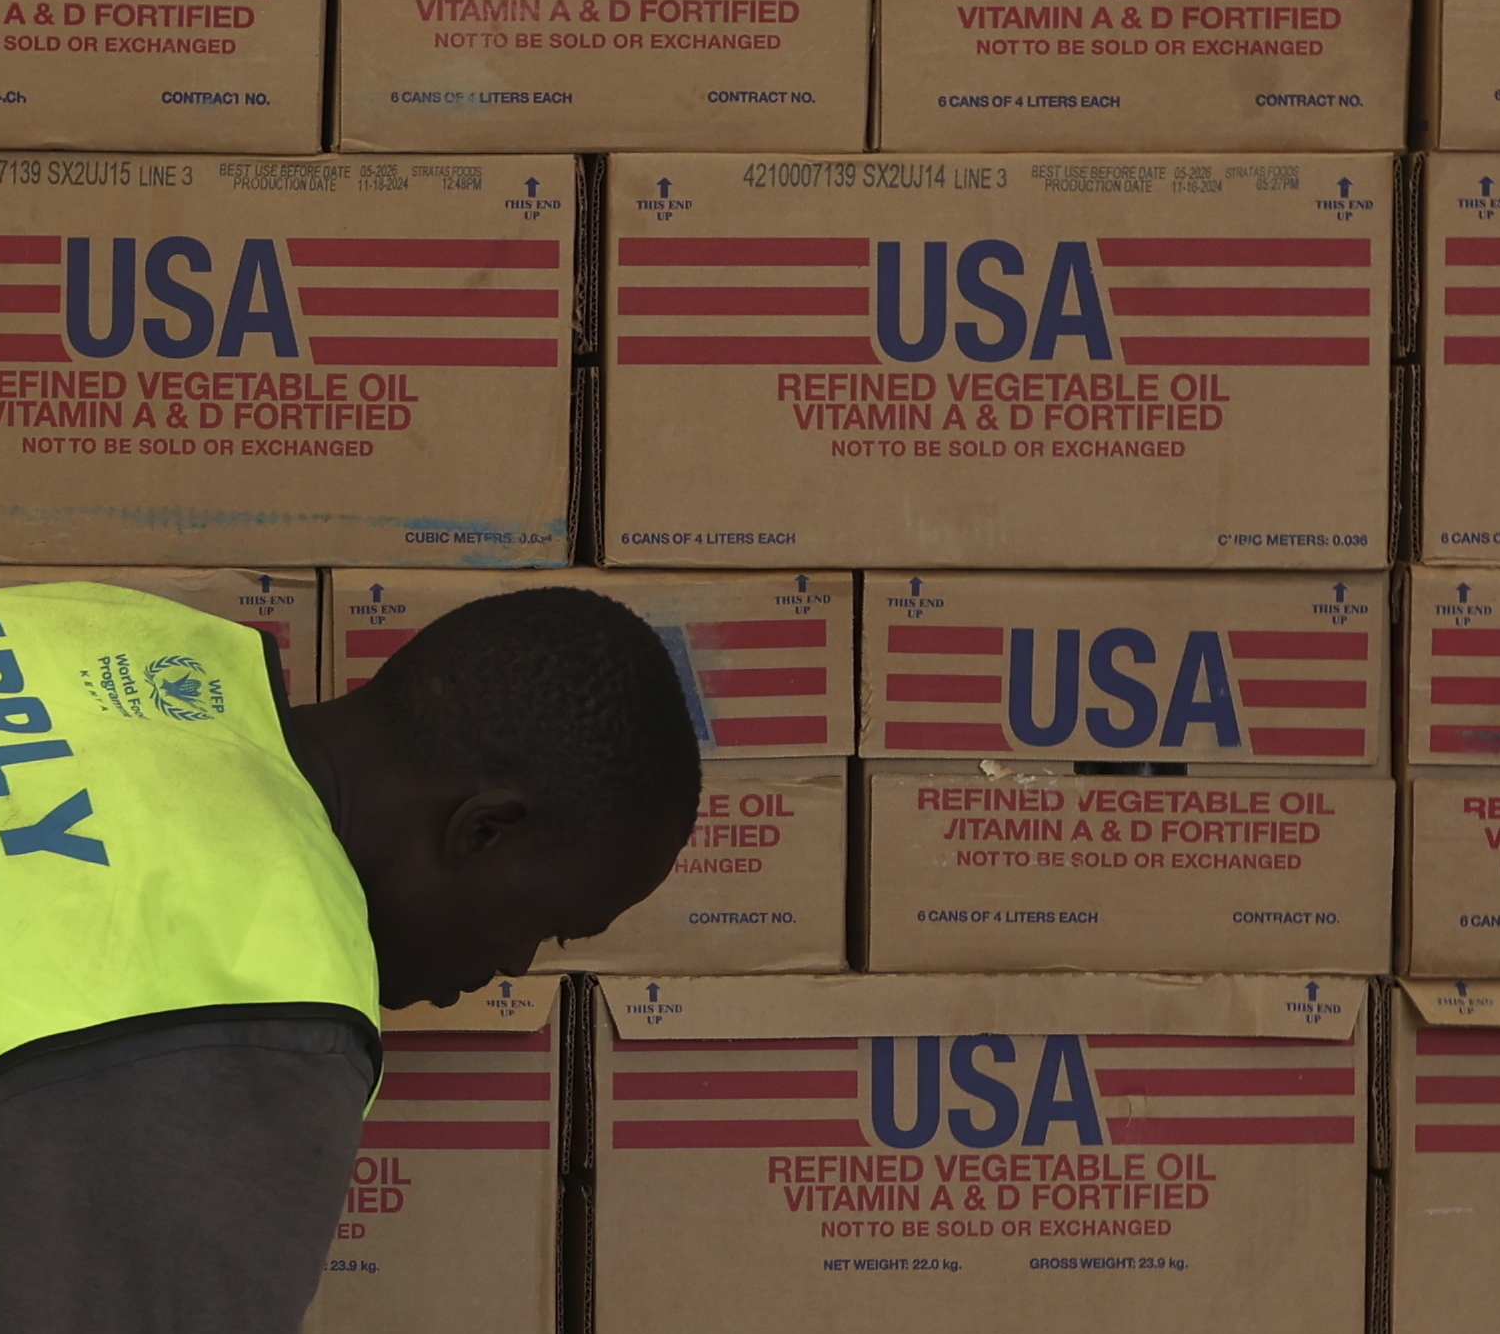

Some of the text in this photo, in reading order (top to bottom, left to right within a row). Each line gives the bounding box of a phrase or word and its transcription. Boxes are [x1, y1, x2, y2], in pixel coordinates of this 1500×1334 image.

[742, 162, 1007, 189] 4210007139 SX2UJ14 LINE 3
[877, 239, 1113, 363] USA
[777, 373, 1230, 402] REFINED VEGETABLE OIL
[793, 403, 1224, 431] VITAMIN A & D FORTIFIED
[831, 440, 1186, 458] NOT TO BE SOLD OR EXCHANGED
[887, 598, 944, 608] THIS END
[907, 609, 923, 618] UP
[115, 653, 138, 695] World
[208, 679, 225, 714] WFP
[1009, 628, 1242, 748] USA
[917, 910, 1099, 924] 6 CANS OF 4 LITERS EACH
[1233, 911, 1313, 925] CONTRACT
[870, 1033, 1104, 1149] USA
[823, 1258, 851, 1271] NET
[912, 1258, 939, 1271] 22.0
[1029, 1257, 1078, 1270] GROSS
[1138, 1257, 1165, 1270] 23.9
